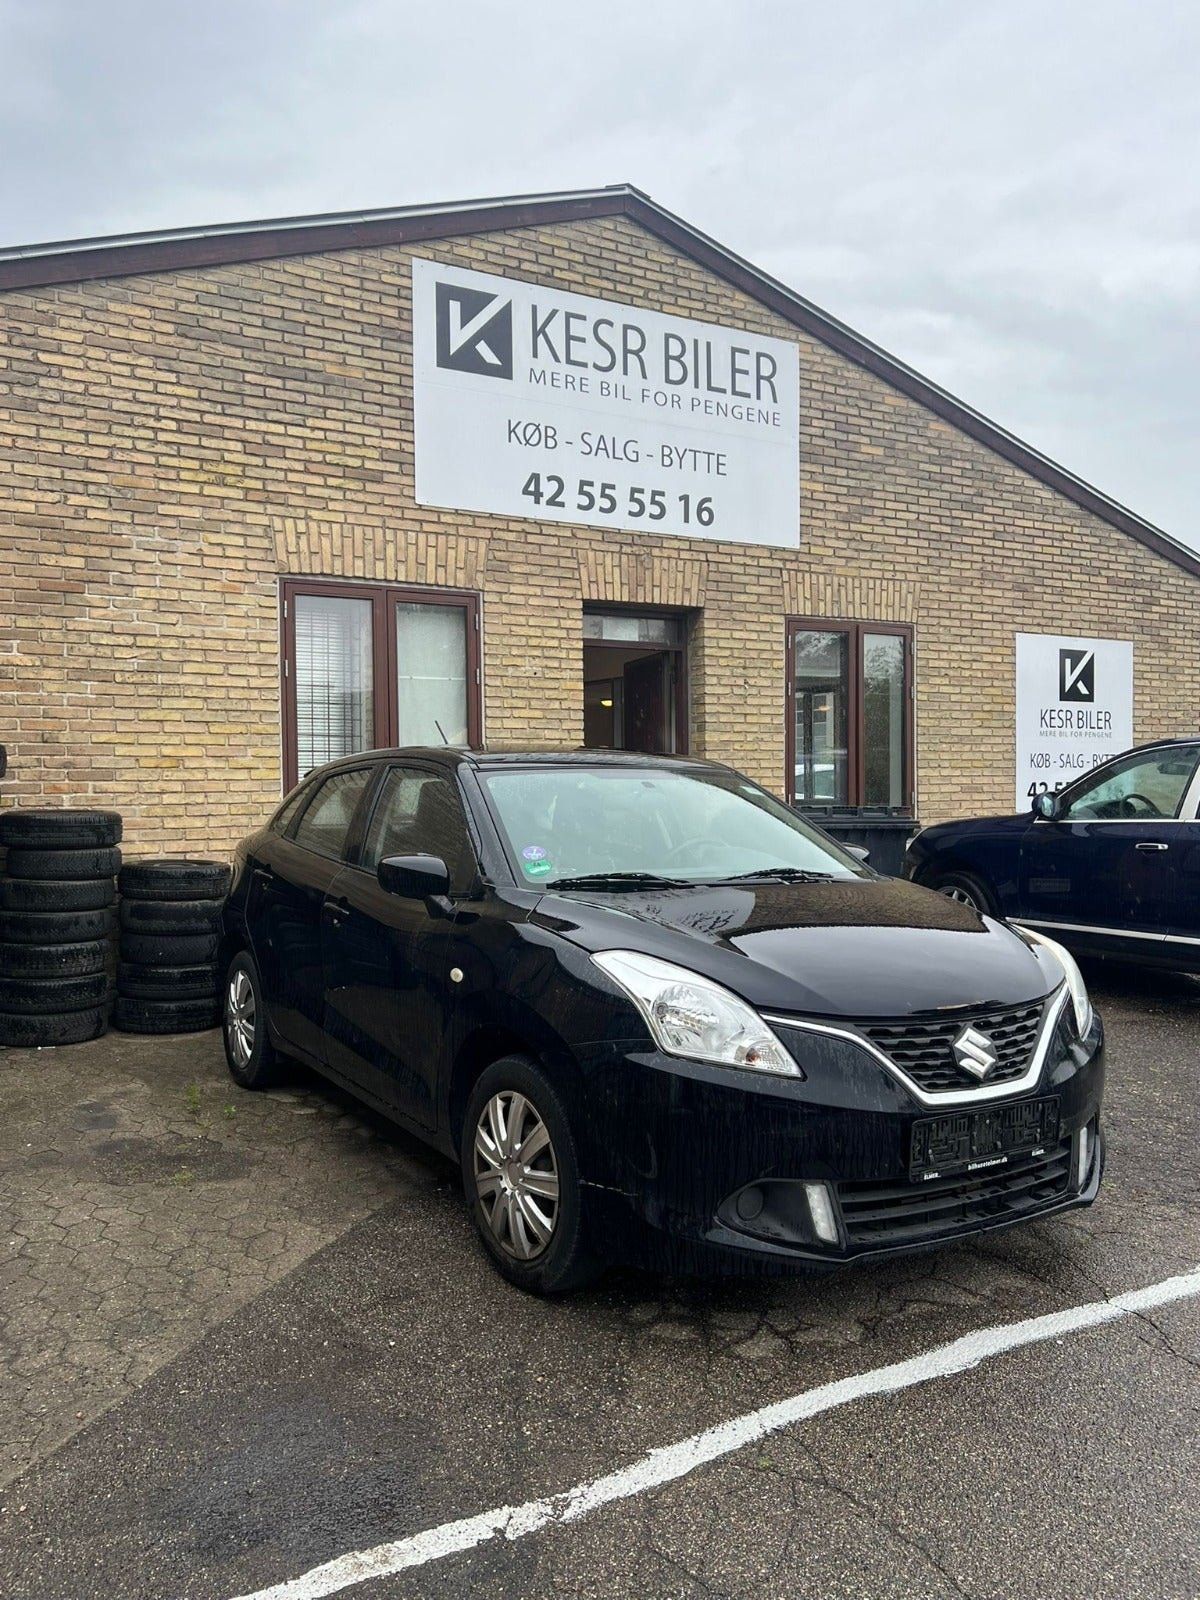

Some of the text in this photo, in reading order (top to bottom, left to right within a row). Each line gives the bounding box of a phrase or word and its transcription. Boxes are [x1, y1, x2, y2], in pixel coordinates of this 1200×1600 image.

[531, 304, 778, 403] KESR BILER
[529, 367, 781, 427] MERE BIL FOR PENGENE
[507, 419, 558, 450] KØB
[580, 432, 640, 462] SALG
[661, 445, 727, 476] BYTTE
[521, 472, 715, 526] 42 55 55 16
[1040, 709, 1112, 730] KESR BILER
[1084, 731, 1112, 739] PENGENE
[1030, 753, 1051, 768] KØB
[1059, 753, 1084, 768] SALG
